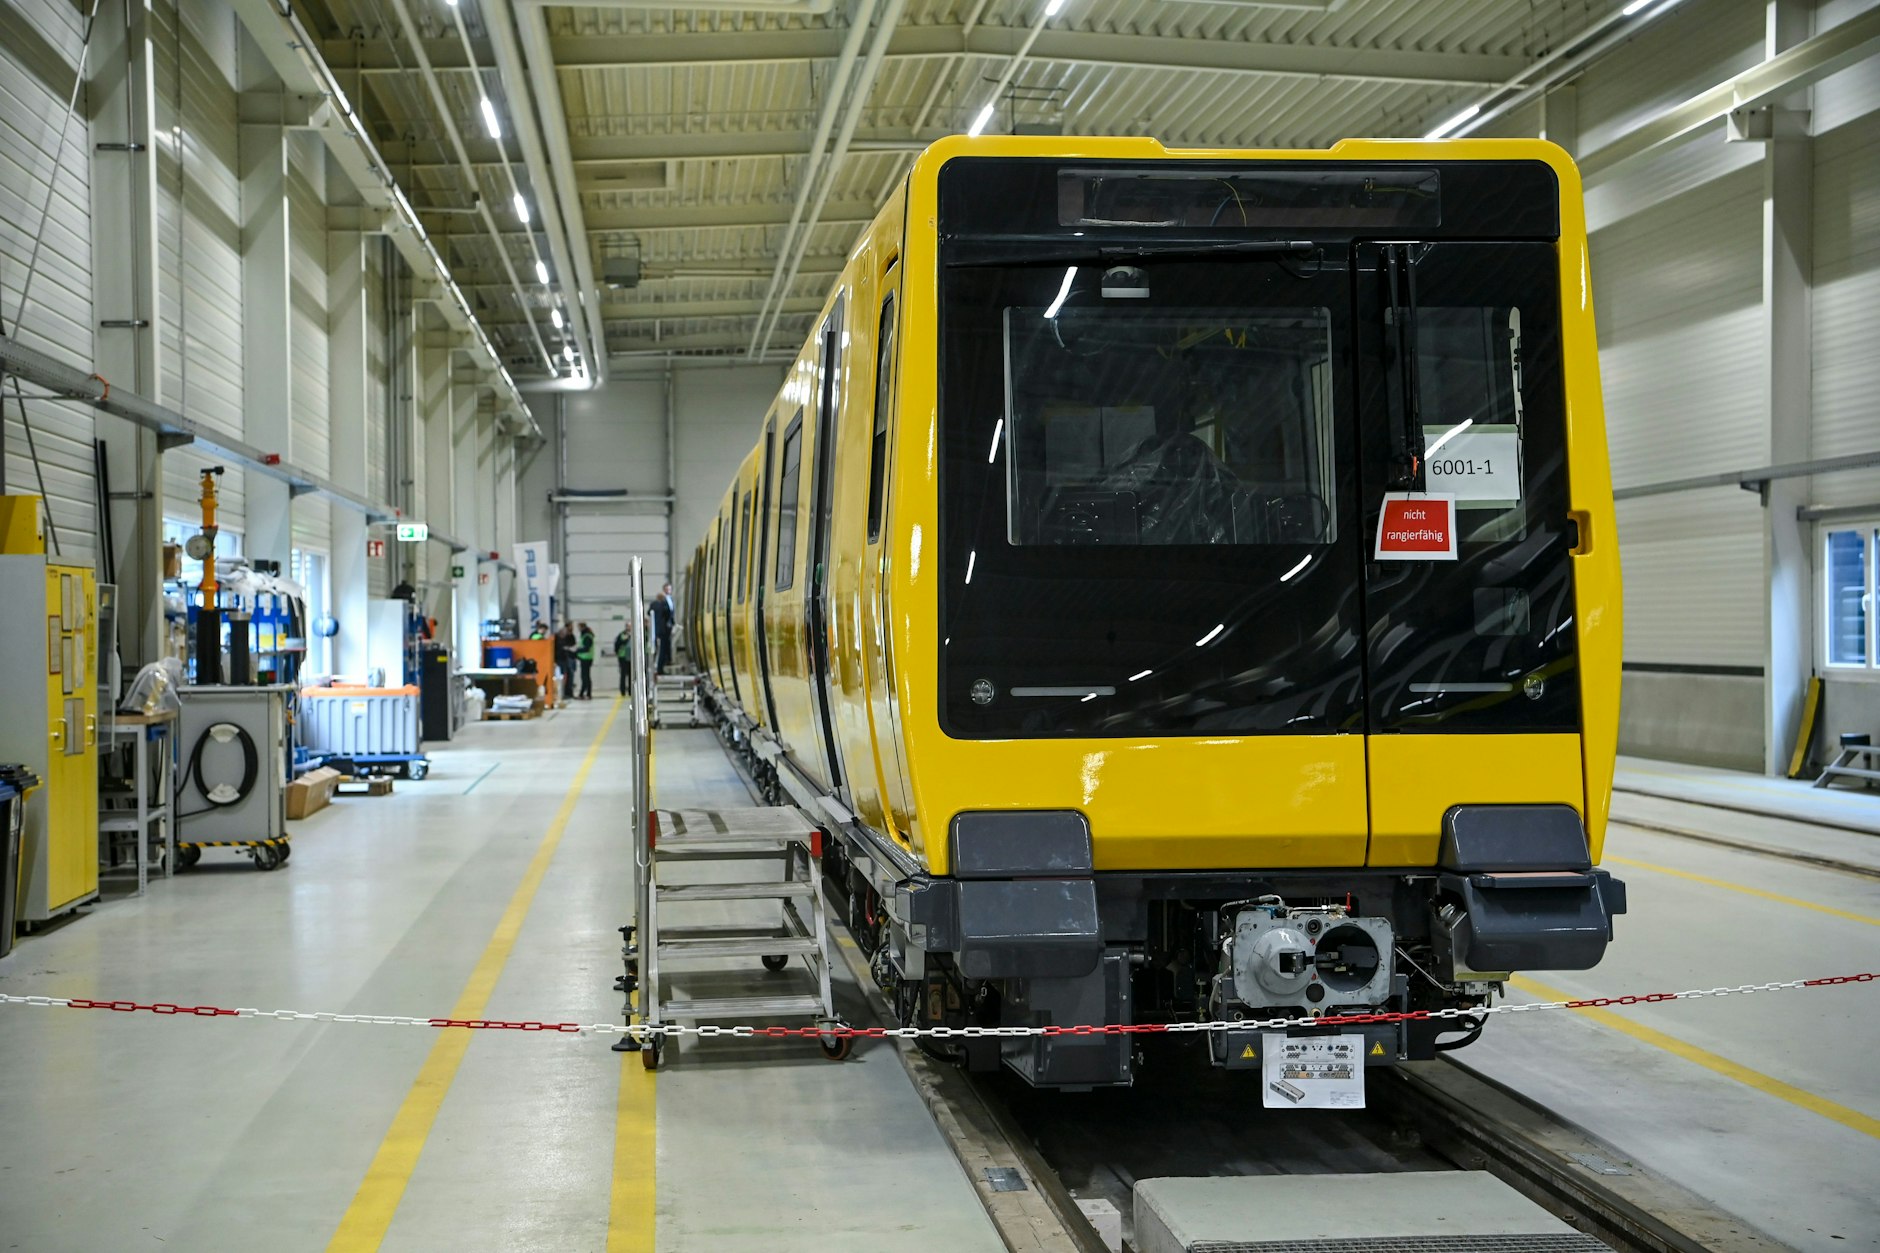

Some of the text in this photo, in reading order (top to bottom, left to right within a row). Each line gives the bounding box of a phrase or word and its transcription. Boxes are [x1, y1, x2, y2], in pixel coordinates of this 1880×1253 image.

[1432, 459, 1494, 476] 6001-1
[1403, 509, 1426, 520] nicht
[1386, 529, 1443, 543] rangierfähig
